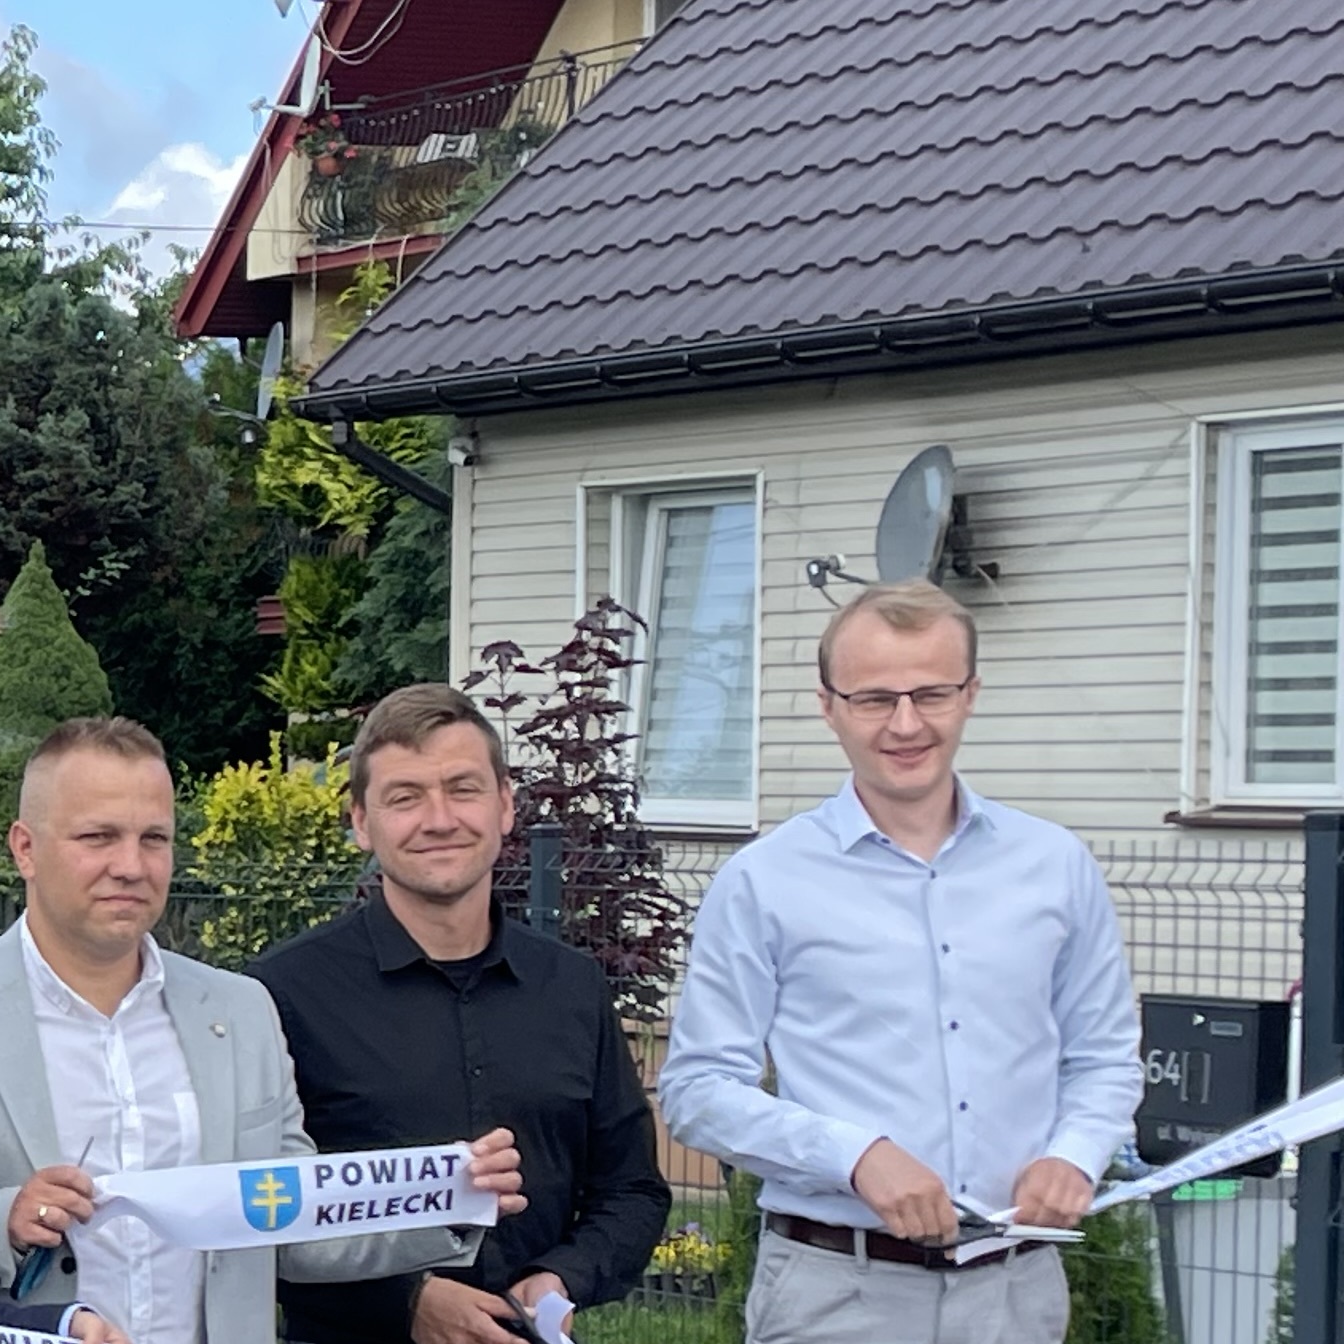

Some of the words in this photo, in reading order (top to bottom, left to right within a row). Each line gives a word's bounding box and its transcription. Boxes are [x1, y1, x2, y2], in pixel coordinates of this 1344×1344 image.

[1146, 1048, 1182, 1086] 64
[314, 1153, 461, 1188] POWIAT
[314, 1186, 453, 1226] KIELECKI
